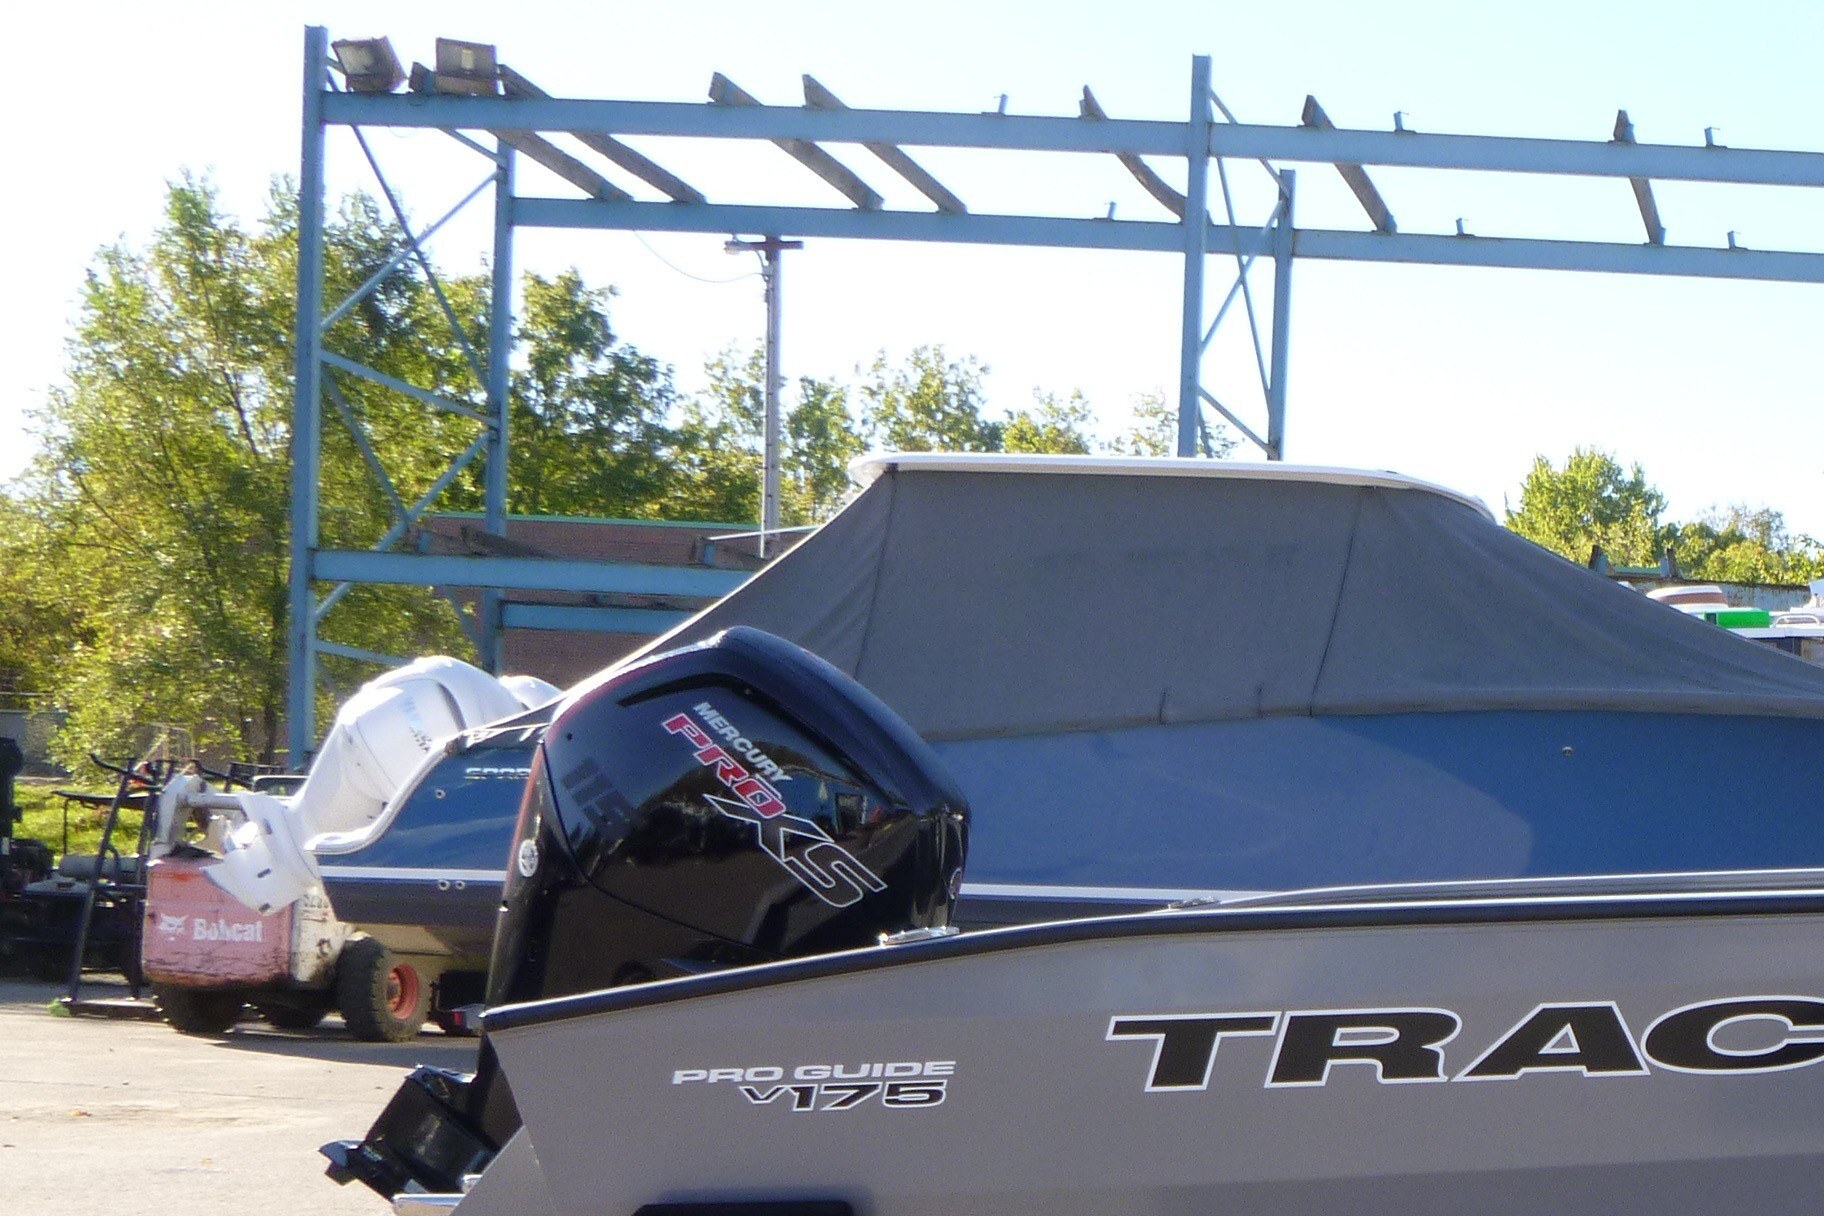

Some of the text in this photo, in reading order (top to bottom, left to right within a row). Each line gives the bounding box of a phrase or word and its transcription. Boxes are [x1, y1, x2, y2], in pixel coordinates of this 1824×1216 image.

[661, 712, 787, 820] PRO
[692, 701, 793, 782] MERCURY
[702, 793, 888, 908] XS
[193, 917, 266, 942] Bobcat
[672, 1060, 957, 1084] PRO GUIDE
[739, 1079, 948, 1111] V175
